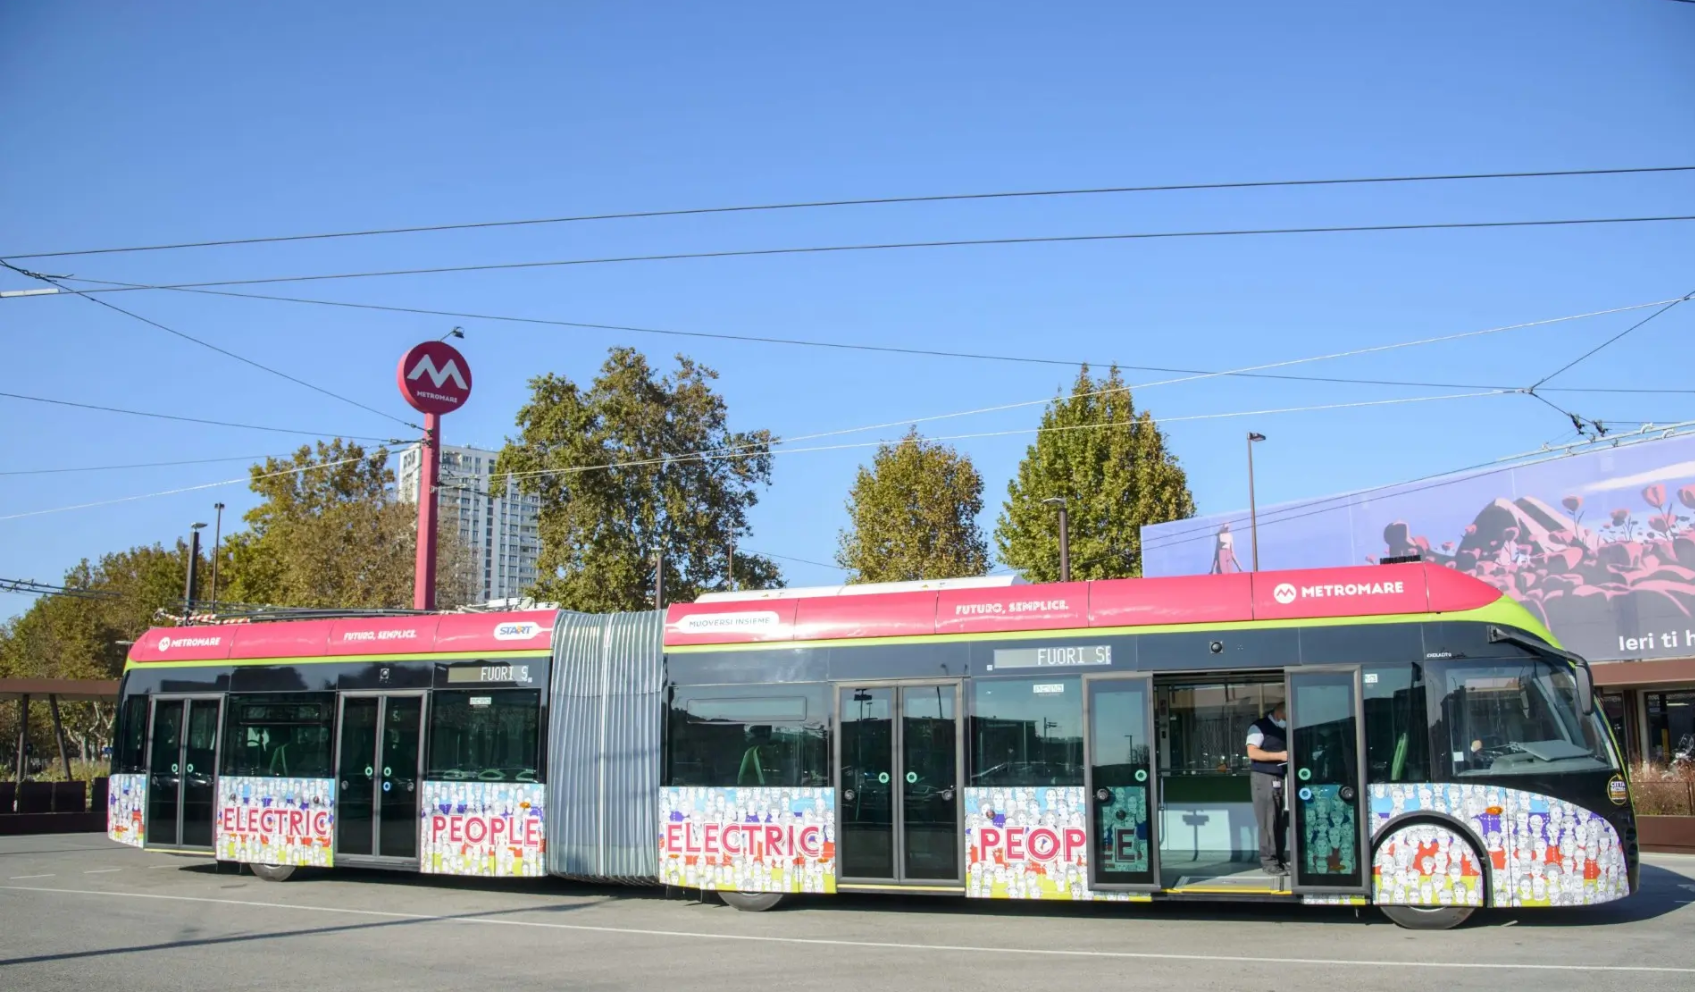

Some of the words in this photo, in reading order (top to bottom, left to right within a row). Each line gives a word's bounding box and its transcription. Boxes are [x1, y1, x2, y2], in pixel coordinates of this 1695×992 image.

[416, 390, 458, 403] METROMARE
[1301, 581, 1404, 598] METROMARE
[955, 603, 1006, 615] FUTURO,
[1008, 600, 1069, 612] SEMPLICE.
[499, 625, 532, 635] START
[688, 619, 733, 628] MUOVERSI
[735, 617, 770, 625] INSIEME
[170, 637, 221, 647] METROMARE
[1618, 632, 1654, 651] Ieri
[1660, 630, 1678, 648] ti
[1037, 647, 1085, 666] FUORI
[481, 666, 514, 681] FUORI
[223, 806, 328, 836] ELECTRIC
[432, 815, 539, 846] PEOPLE
[667, 822, 820, 858] ELECTRIC
[979, 827, 1136, 862] PEOPE
